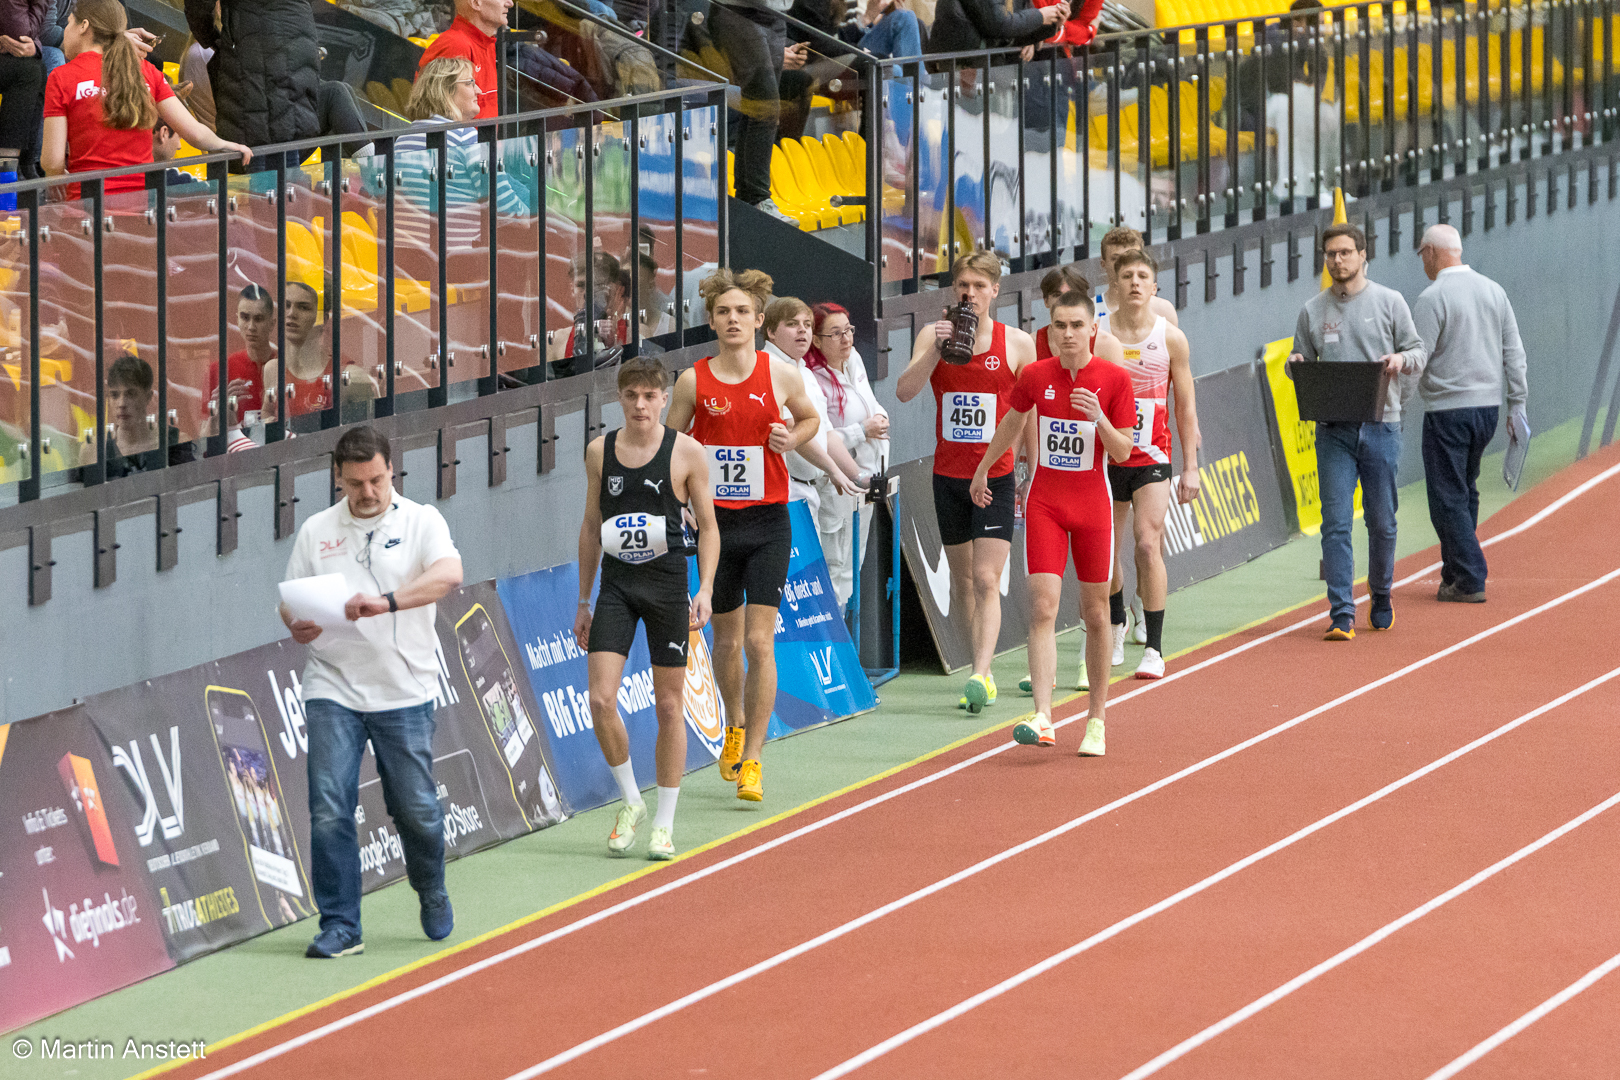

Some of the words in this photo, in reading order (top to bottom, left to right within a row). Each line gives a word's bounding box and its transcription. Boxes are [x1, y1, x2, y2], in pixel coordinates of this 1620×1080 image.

[950, 408, 986, 427] 450
[1047, 434, 1084, 455] 640
[720, 463, 747, 483] 12
[1061, 457, 1080, 465] PLAN
[620, 529, 649, 550] 29
[633, 551, 653, 559] PLAN
[525, 636, 554, 670] Macht
[550, 633, 567, 664] mit
[560, 629, 579, 660] bei
[542, 686, 577, 739] BIG
[566, 684, 595, 731] Fa
[111, 725, 185, 847] DLV
[450, 802, 483, 835] Store
[378, 826, 407, 865] Play
[69, 887, 141, 948] diefinals.de
